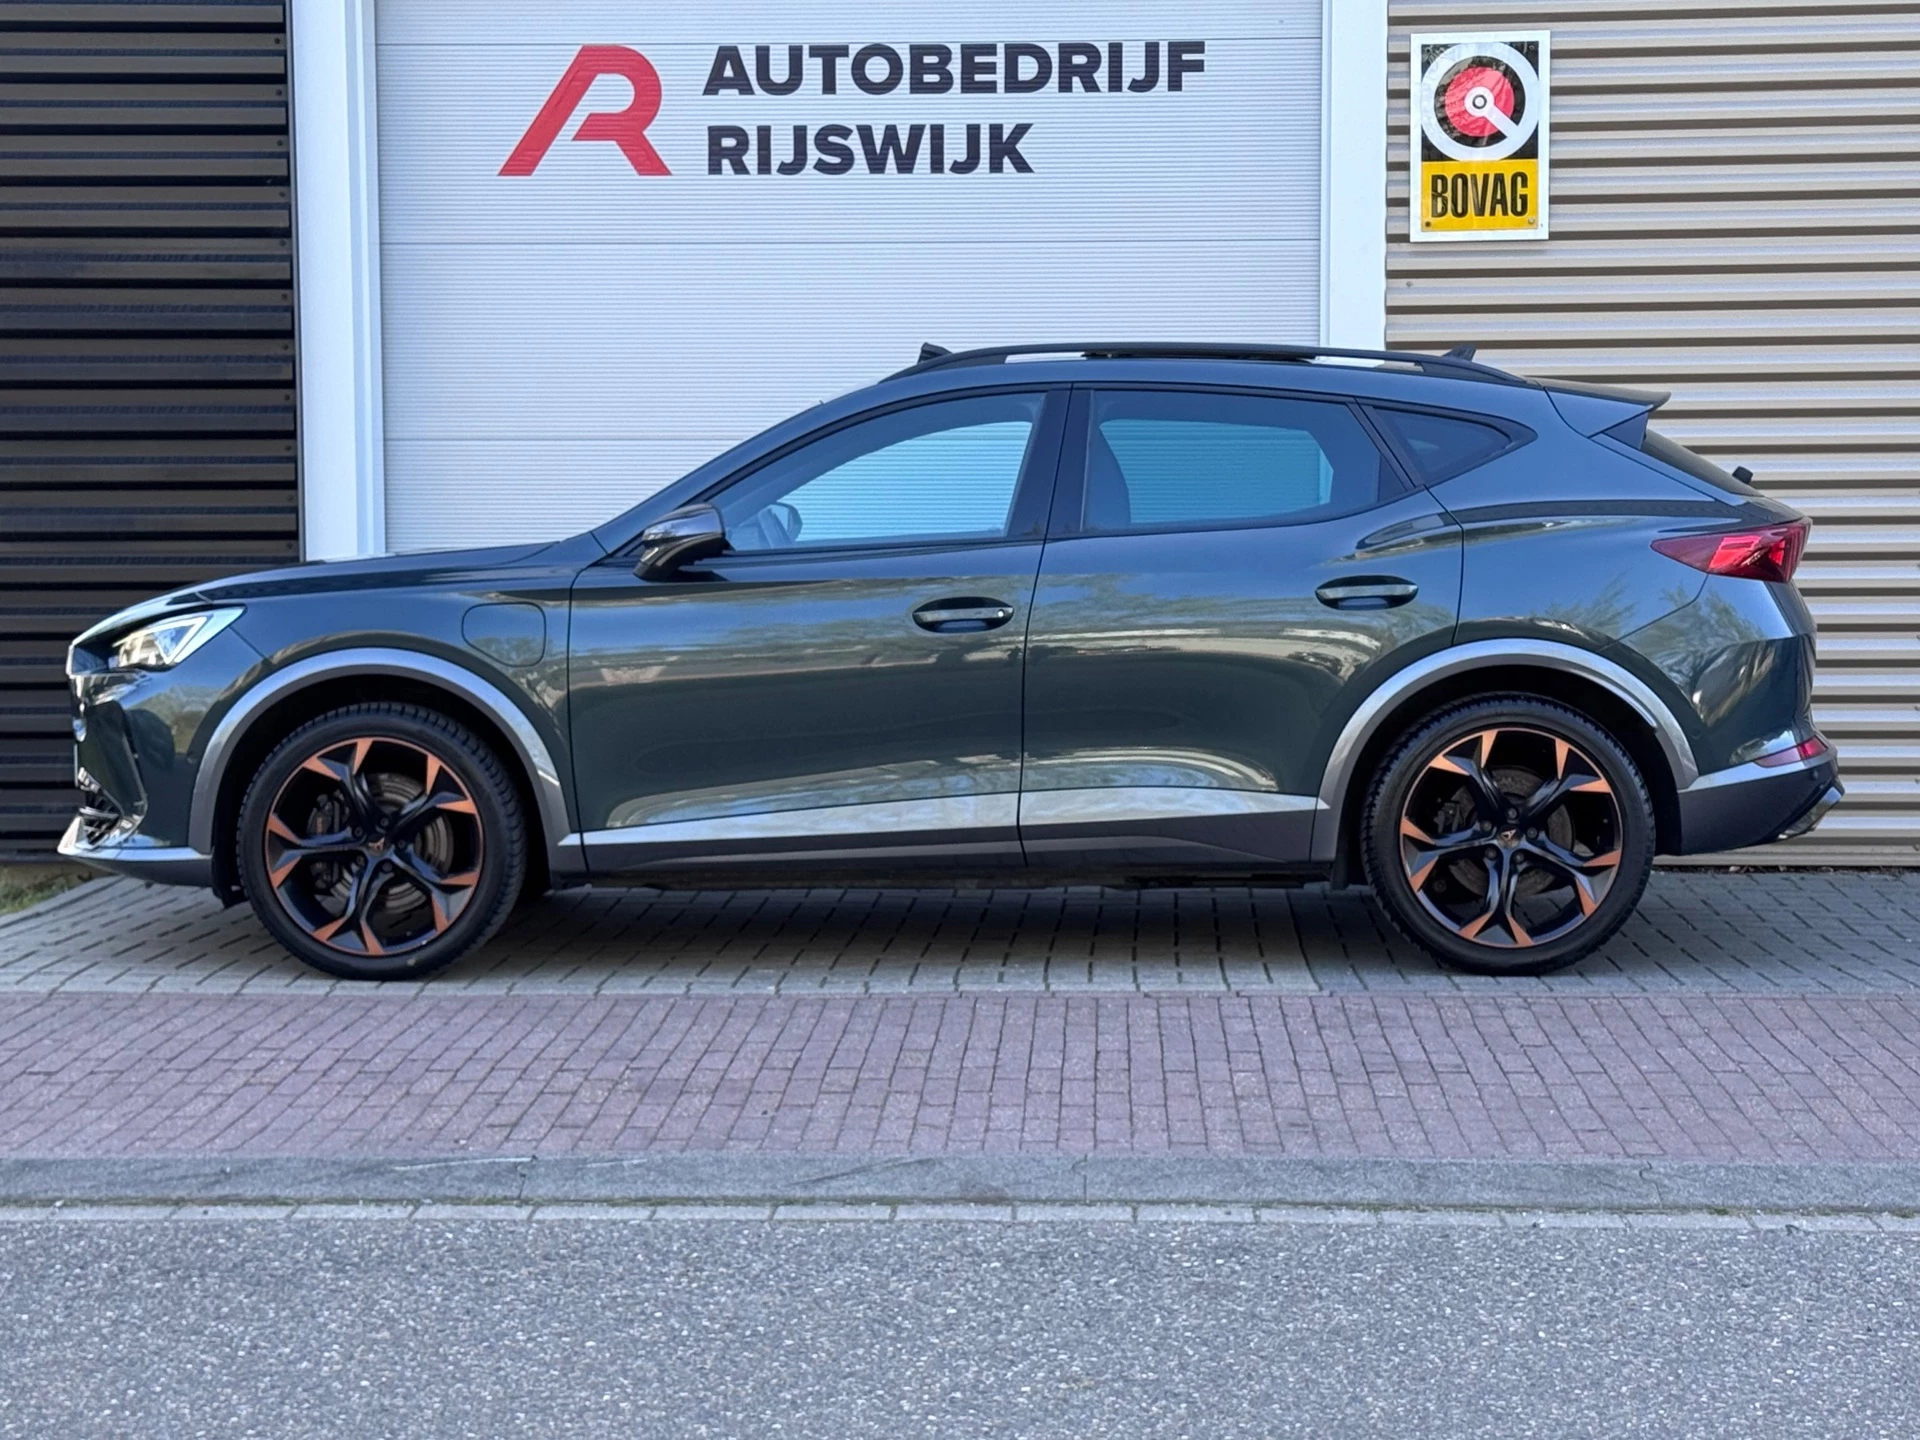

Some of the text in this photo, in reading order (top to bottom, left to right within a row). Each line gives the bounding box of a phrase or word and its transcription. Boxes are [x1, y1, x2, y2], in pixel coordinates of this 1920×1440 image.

[702, 41, 1206, 95] AUTOBEDRIJF
[707, 123, 1035, 175] RIJSWIJK
[1430, 171, 1529, 218] BOVAG
